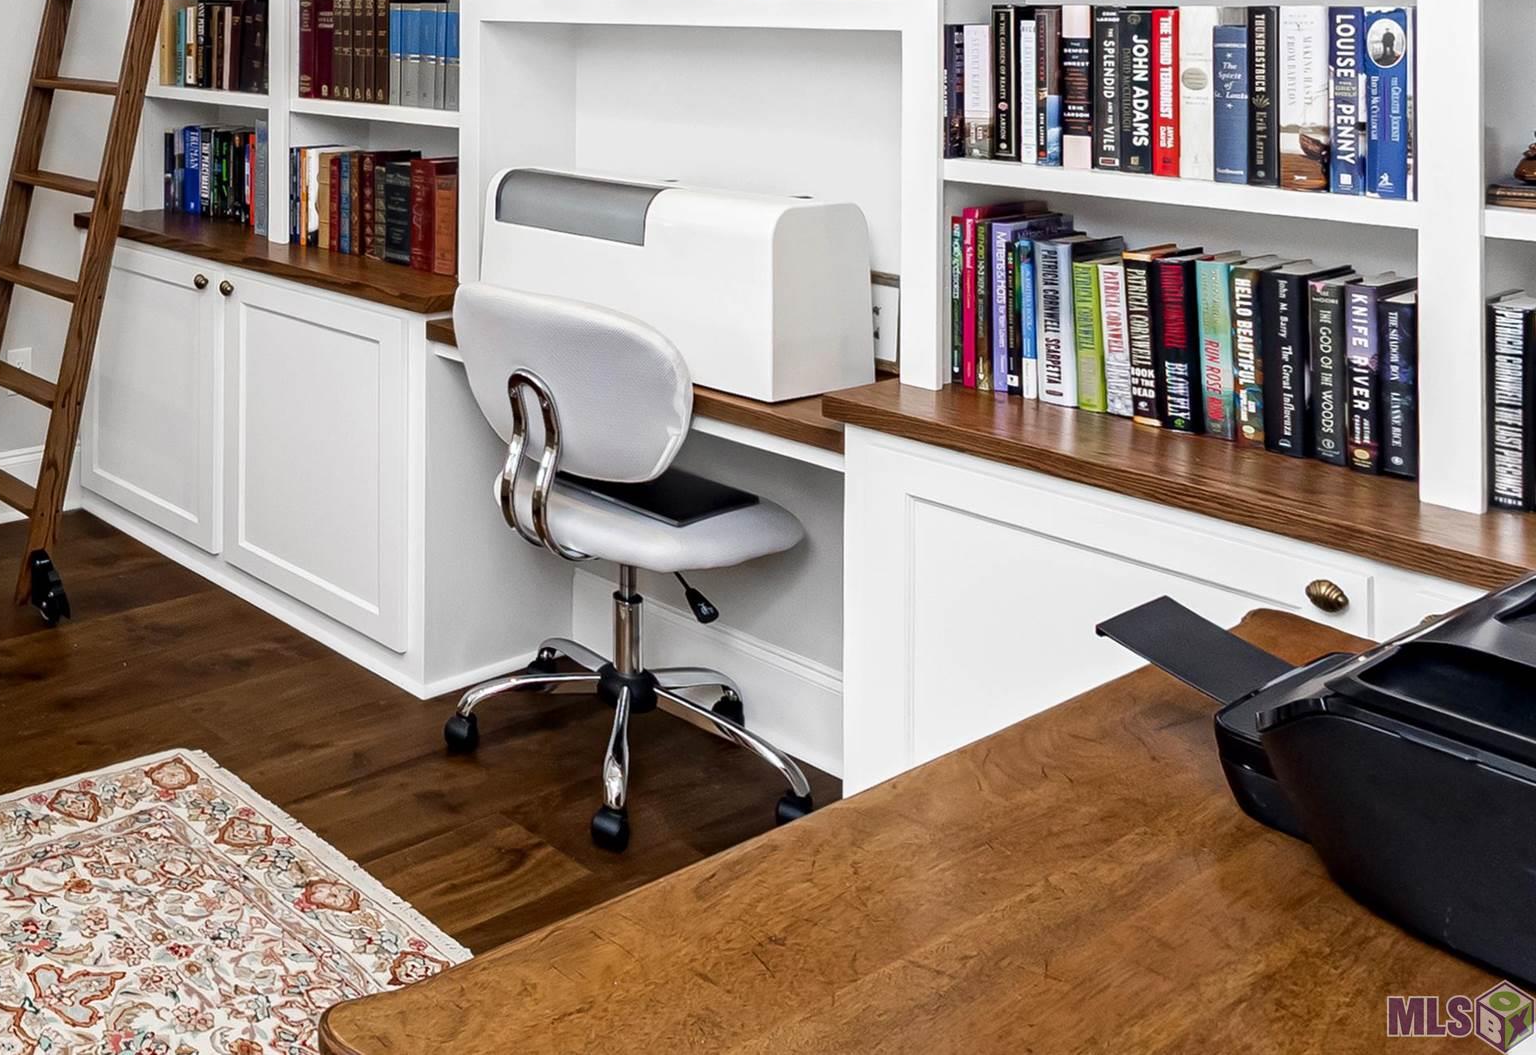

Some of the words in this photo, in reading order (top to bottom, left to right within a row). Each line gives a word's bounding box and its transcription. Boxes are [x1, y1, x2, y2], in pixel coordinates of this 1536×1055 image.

[1160, 16, 1172, 34] THE
[1122, 48, 1131, 72] DAVID
[1132, 34, 1148, 81] JOHN
[1160, 36, 1172, 65] THIRD
[1255, 14, 1265, 92] THUNDERSTRUCK
[1287, 35, 1296, 62] FROM
[1303, 36, 1313, 73] MAKING
[1336, 15, 1355, 77] LOUISE
[1000, 66, 1006, 74] OF
[1103, 40, 1115, 98] SPLENDID
[1218, 71, 1242, 80] Spirit
[1222, 62, 1238, 70] The
[1160, 67, 1172, 119] TERRORIST
[1224, 81, 1234, 90] of
[1287, 65, 1296, 106] BABYLON
[1304, 77, 1313, 106] HASTE
[1370, 76, 1379, 95] DAVID
[1391, 87, 1401, 114] GREATER
[1132, 87, 1148, 146] ADAMS
[1256, 112, 1267, 131] Erik
[1390, 115, 1402, 142] JOURNEY
[202, 143, 210, 153] THE
[1103, 126, 1115, 151] VILE
[1336, 104, 1356, 164] PENNY
[190, 131, 199, 169] TRUMAN
[1256, 135, 1266, 165] Larson
[996, 231, 1007, 270] Mittens
[1042, 250, 1058, 285] PATRICIA
[997, 280, 1006, 304] Hats
[1075, 266, 1092, 303] PATRICIA
[1103, 271, 1119, 308] PATRICIA
[1127, 268, 1149, 311] PATRICIA
[1235, 278, 1252, 316] HELLO
[1277, 280, 1288, 298] John
[1044, 289, 1060, 333] CORNWELL
[1279, 303, 1288, 313] M.
[1320, 310, 1331, 323] THE
[1352, 294, 1368, 348] KNIFE
[1389, 312, 1397, 326] THE
[1078, 307, 1094, 351] CORNWELL
[1106, 311, 1124, 353] CORNWELL
[1130, 315, 1151, 366] CORNWELL
[1278, 316, 1288, 338] Barry
[1320, 327, 1332, 353] GOD
[1495, 309, 1522, 355] PATRICIA
[1205, 339, 1220, 364] RUN
[1237, 320, 1254, 385] BEAUTIFUL
[1282, 345, 1292, 362] The
[1389, 328, 1399, 362] SHADOW
[1045, 338, 1061, 384] SCARPETTA
[1131, 366, 1155, 378] BOOK
[1321, 356, 1332, 369] OF
[1390, 365, 1400, 380] BOX
[1165, 361, 1188, 395] BLOW
[1206, 365, 1221, 394] ROSE
[1282, 365, 1292, 389] Great
[1321, 373, 1332, 386] THE
[1352, 356, 1370, 411] RIVER
[1495, 355, 1522, 406] CORNWELL
[1133, 386, 1155, 398] DEAD
[1167, 395, 1190, 420] FLY
[1207, 397, 1224, 421] RUN
[1283, 393, 1294, 435] Influenza
[1322, 391, 1334, 433] WOODS
[1391, 392, 1401, 425] LUANNE
[1495, 407, 1522, 426] THE
[1392, 427, 1402, 447] RICE
[1495, 424, 1522, 450] LAST
[1494, 448, 1522, 498] PRECINCT
